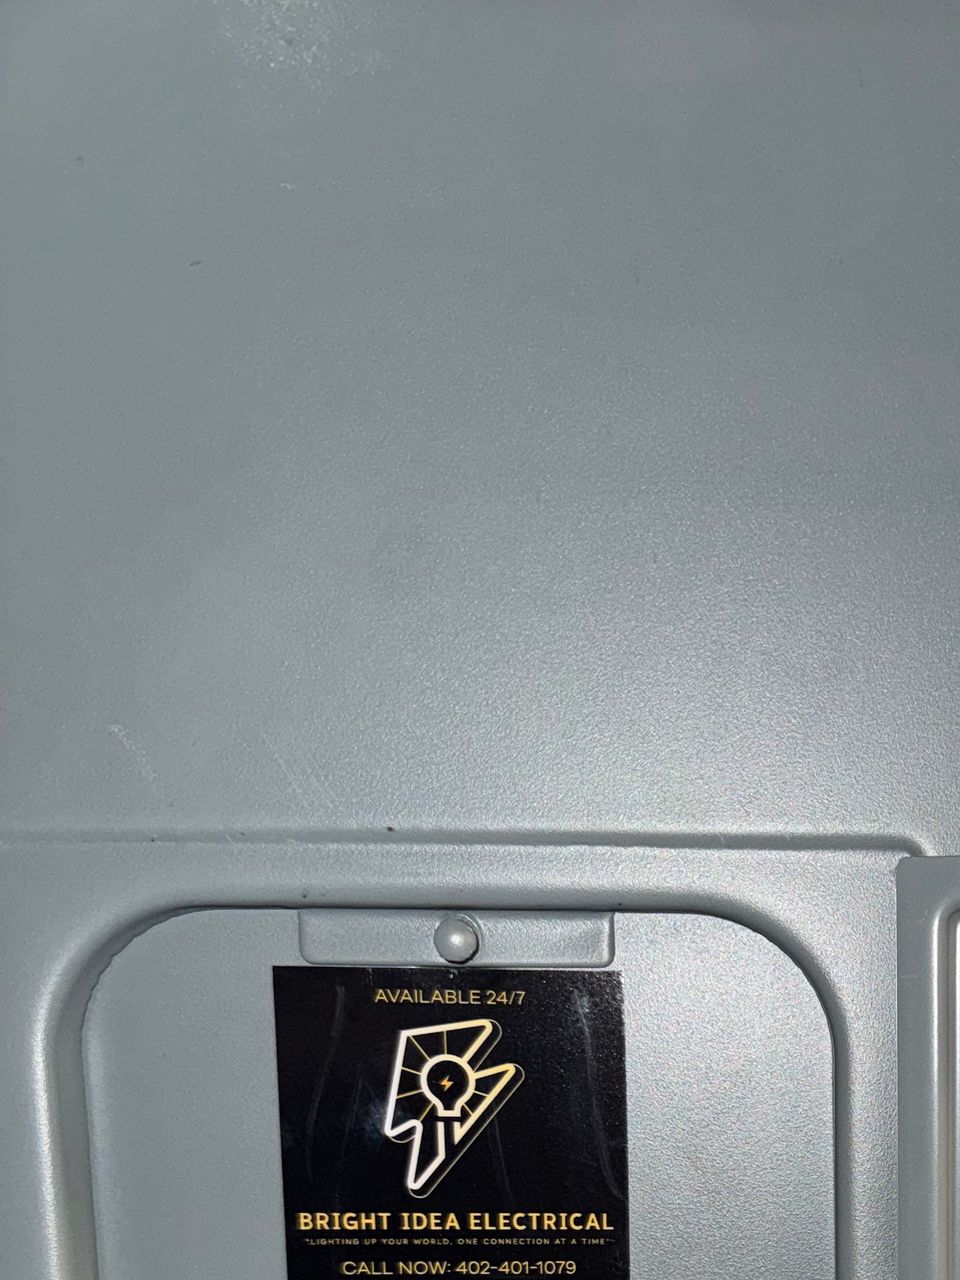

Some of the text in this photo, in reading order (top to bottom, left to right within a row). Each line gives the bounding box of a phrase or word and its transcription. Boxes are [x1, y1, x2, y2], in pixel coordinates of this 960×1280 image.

[375, 989, 525, 1006] AVAILABLE 24/7
[299, 1212, 614, 1231] BRIGHT IDEA ELECTRICAL
[364, 1238, 377, 1246] UP
[382, 1238, 408, 1246] YOUR
[457, 1238, 478, 1246] ONE
[483, 1238, 550, 1246] CONNECTION
[554, 1238, 566, 1246] AT
[571, 1238, 578, 1246] A
[342, 1260, 577, 1275] CALL NOW: 402-401-1079
